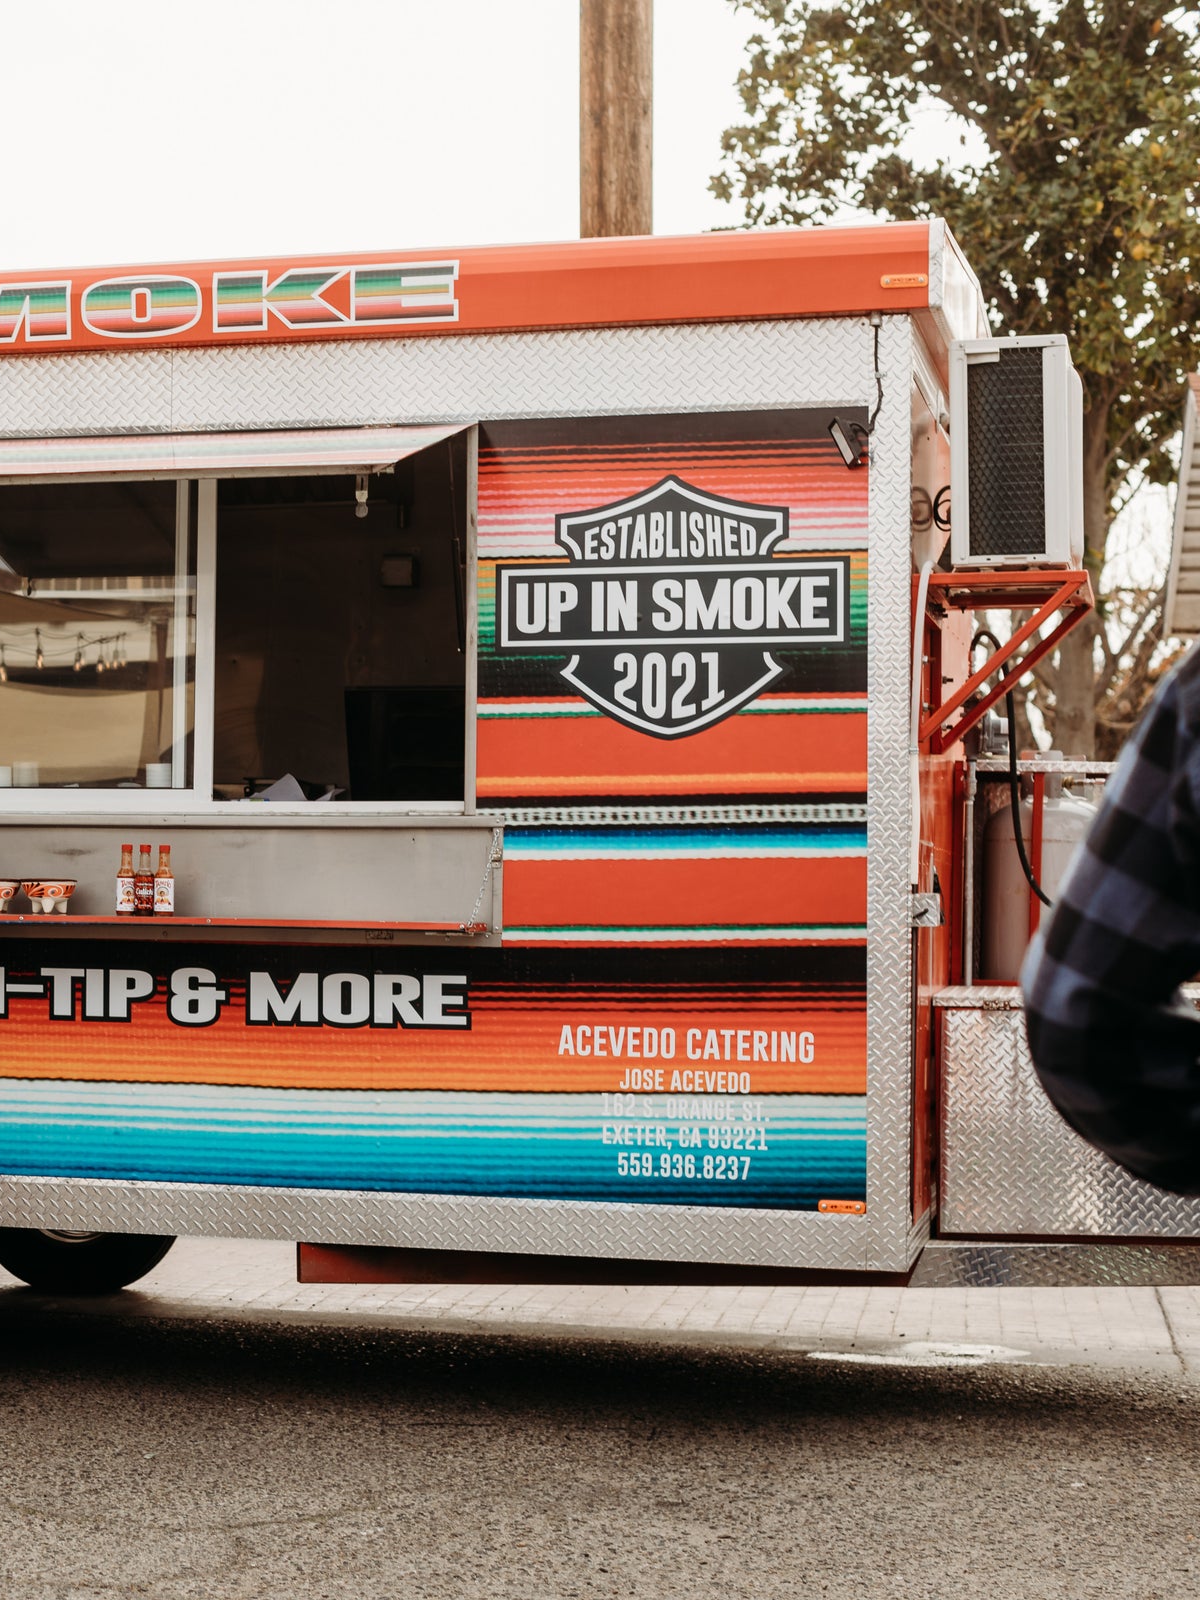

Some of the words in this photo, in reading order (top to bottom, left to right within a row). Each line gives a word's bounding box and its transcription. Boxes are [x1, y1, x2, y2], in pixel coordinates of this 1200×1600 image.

[583, 510, 757, 561] ESTABLISHED
[515, 582, 579, 634] UP
[591, 580, 638, 632] IN
[651, 576, 830, 631] SMOKE
[613, 651, 725, 720] 2021
[170, 966, 225, 1024] &
[247, 971, 468, 1026] MORE
[558, 1024, 676, 1059] ACEVEDO
[686, 1028, 815, 1064] CATERING
[619, 1068, 664, 1091] JOSE
[670, 1069, 751, 1094] ACEVEDO
[601, 1092, 636, 1118] 162
[666, 1097, 735, 1121] ORANGE
[742, 1100, 770, 1122] ST.
[601, 1124, 673, 1150] EXETER,
[678, 1125, 702, 1149] CA
[708, 1124, 768, 1151] 93221
[617, 1151, 751, 1181] 559.936.8237
